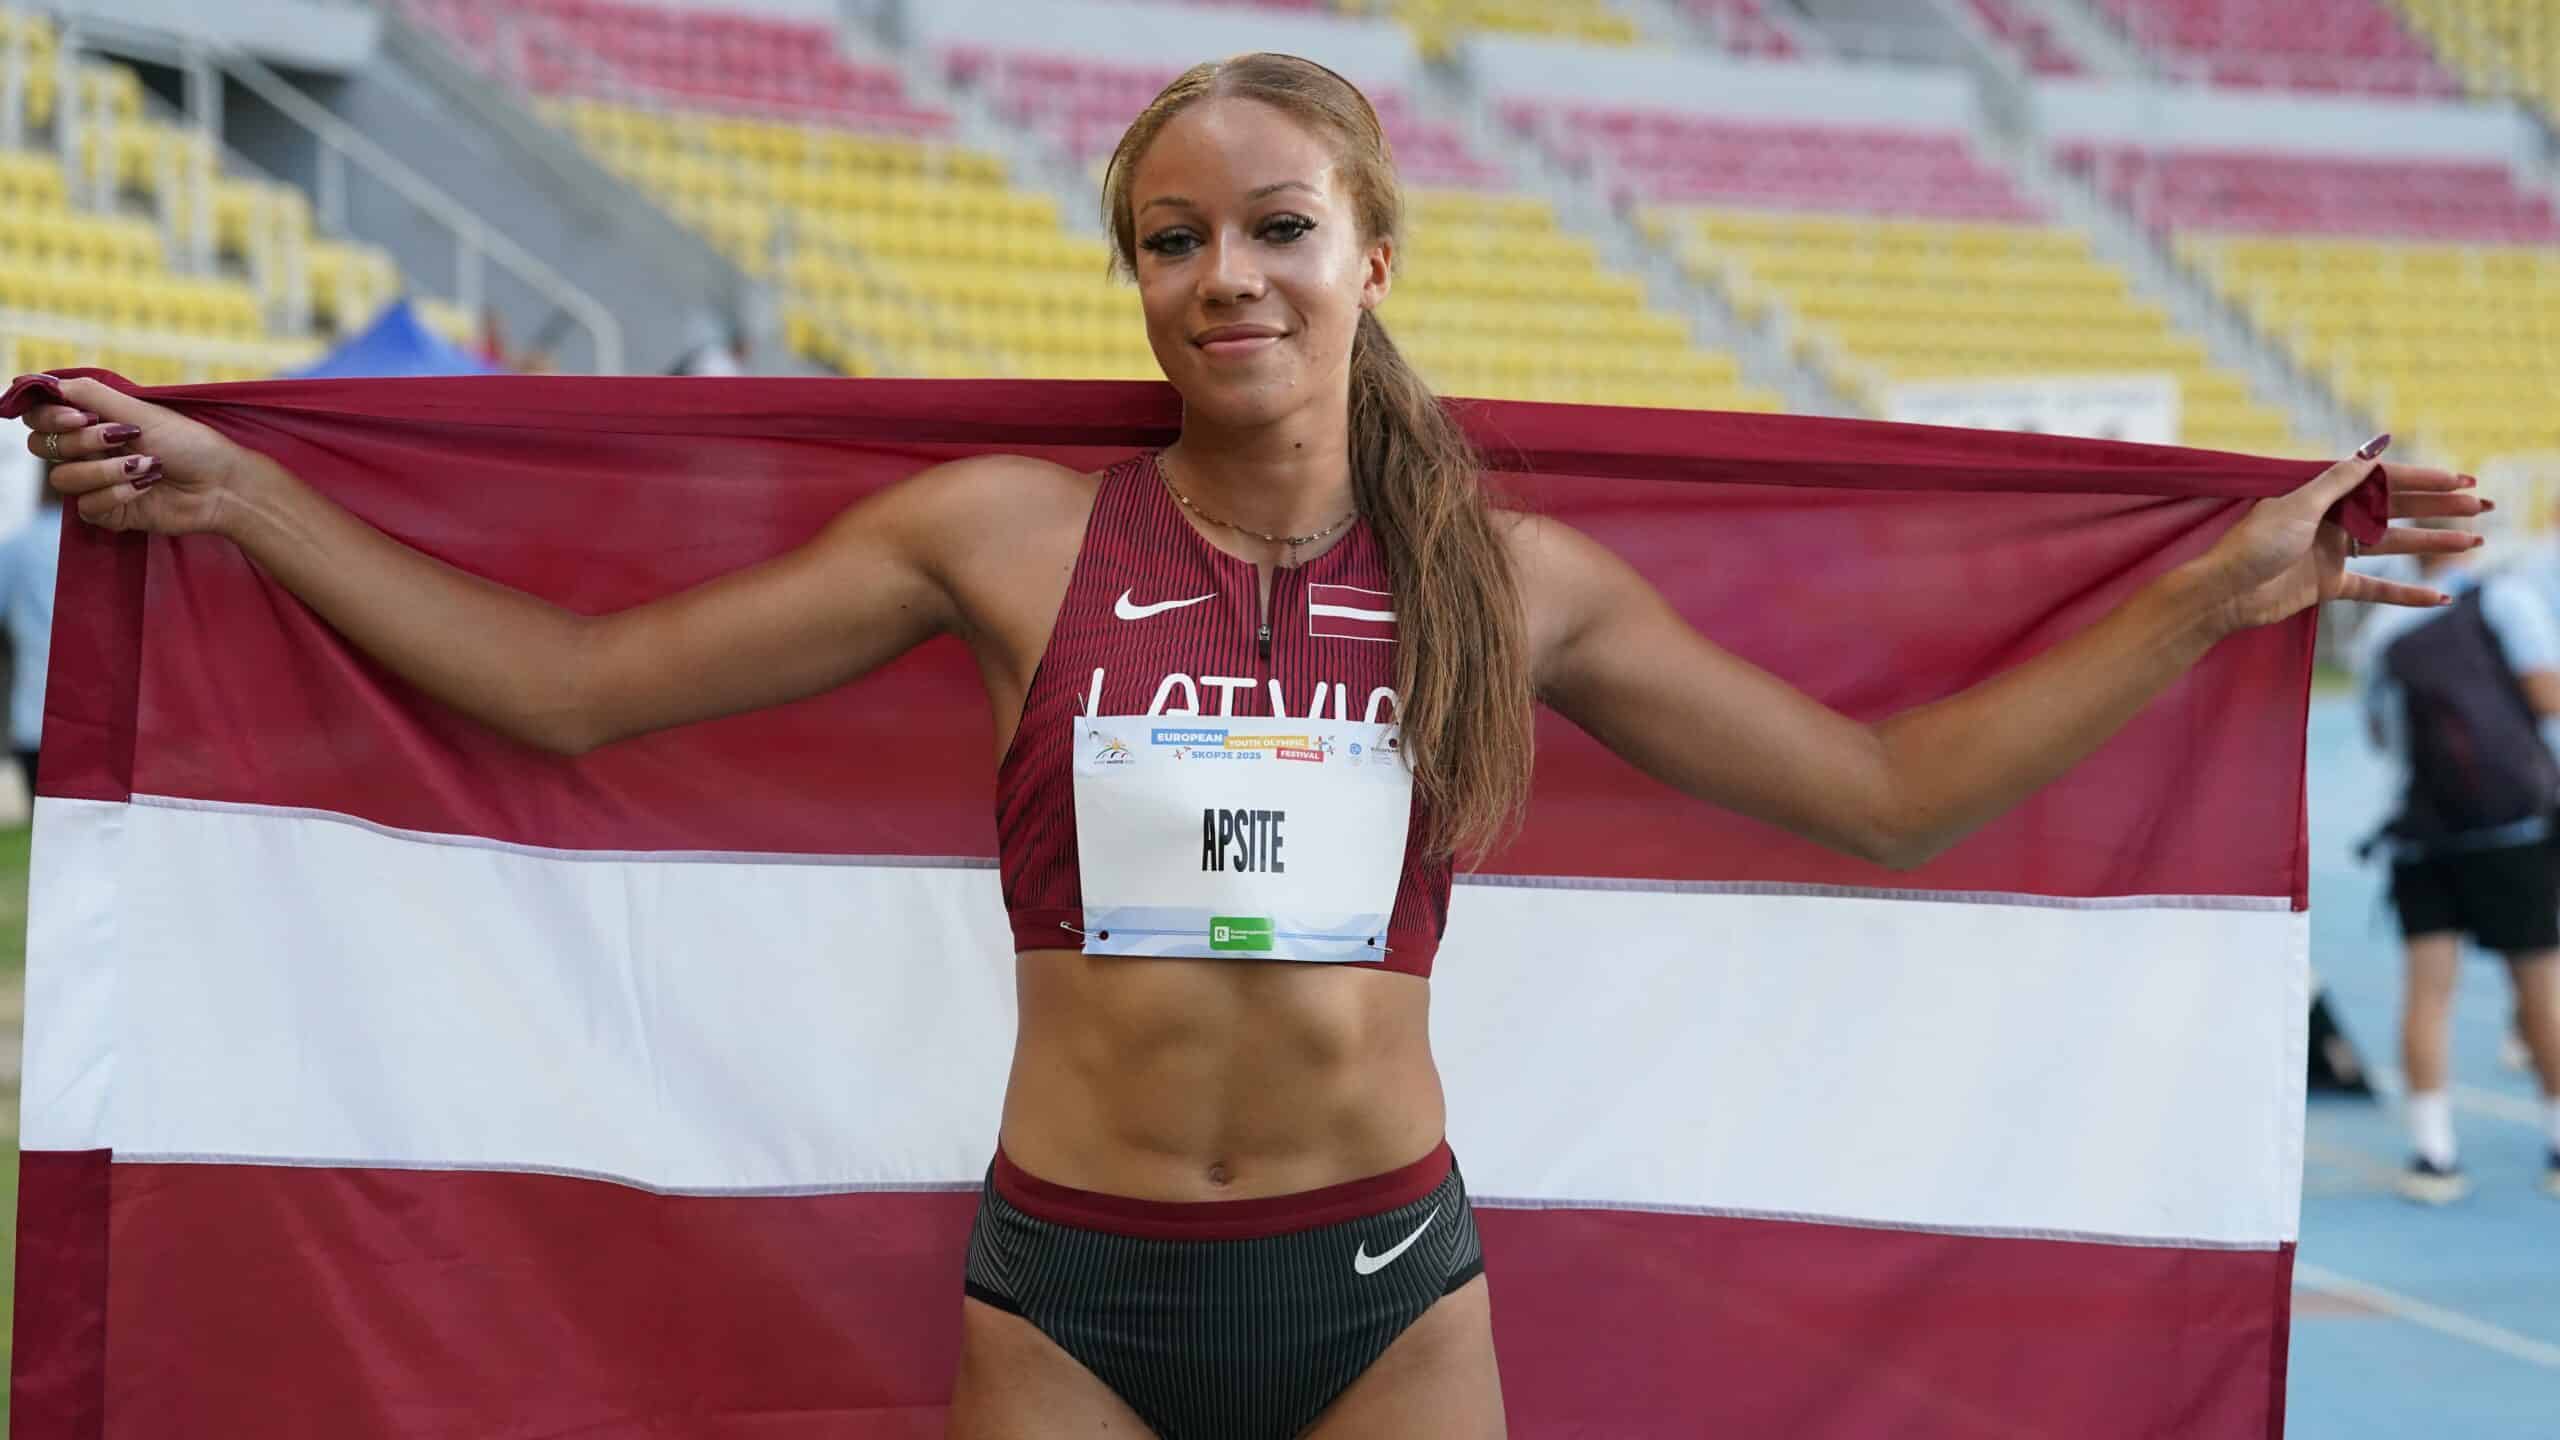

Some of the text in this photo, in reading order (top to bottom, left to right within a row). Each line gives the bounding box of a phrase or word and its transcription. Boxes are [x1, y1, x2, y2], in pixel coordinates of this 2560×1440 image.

[1156, 732, 1223, 743] EUROPEAN
[1229, 739, 1306, 748] YOUTH OLYMPIC
[1191, 751, 1262, 760] SKOPJE 2025
[1280, 750, 1320, 760] FESTIVAL
[1201, 808, 1285, 873] APSITE
